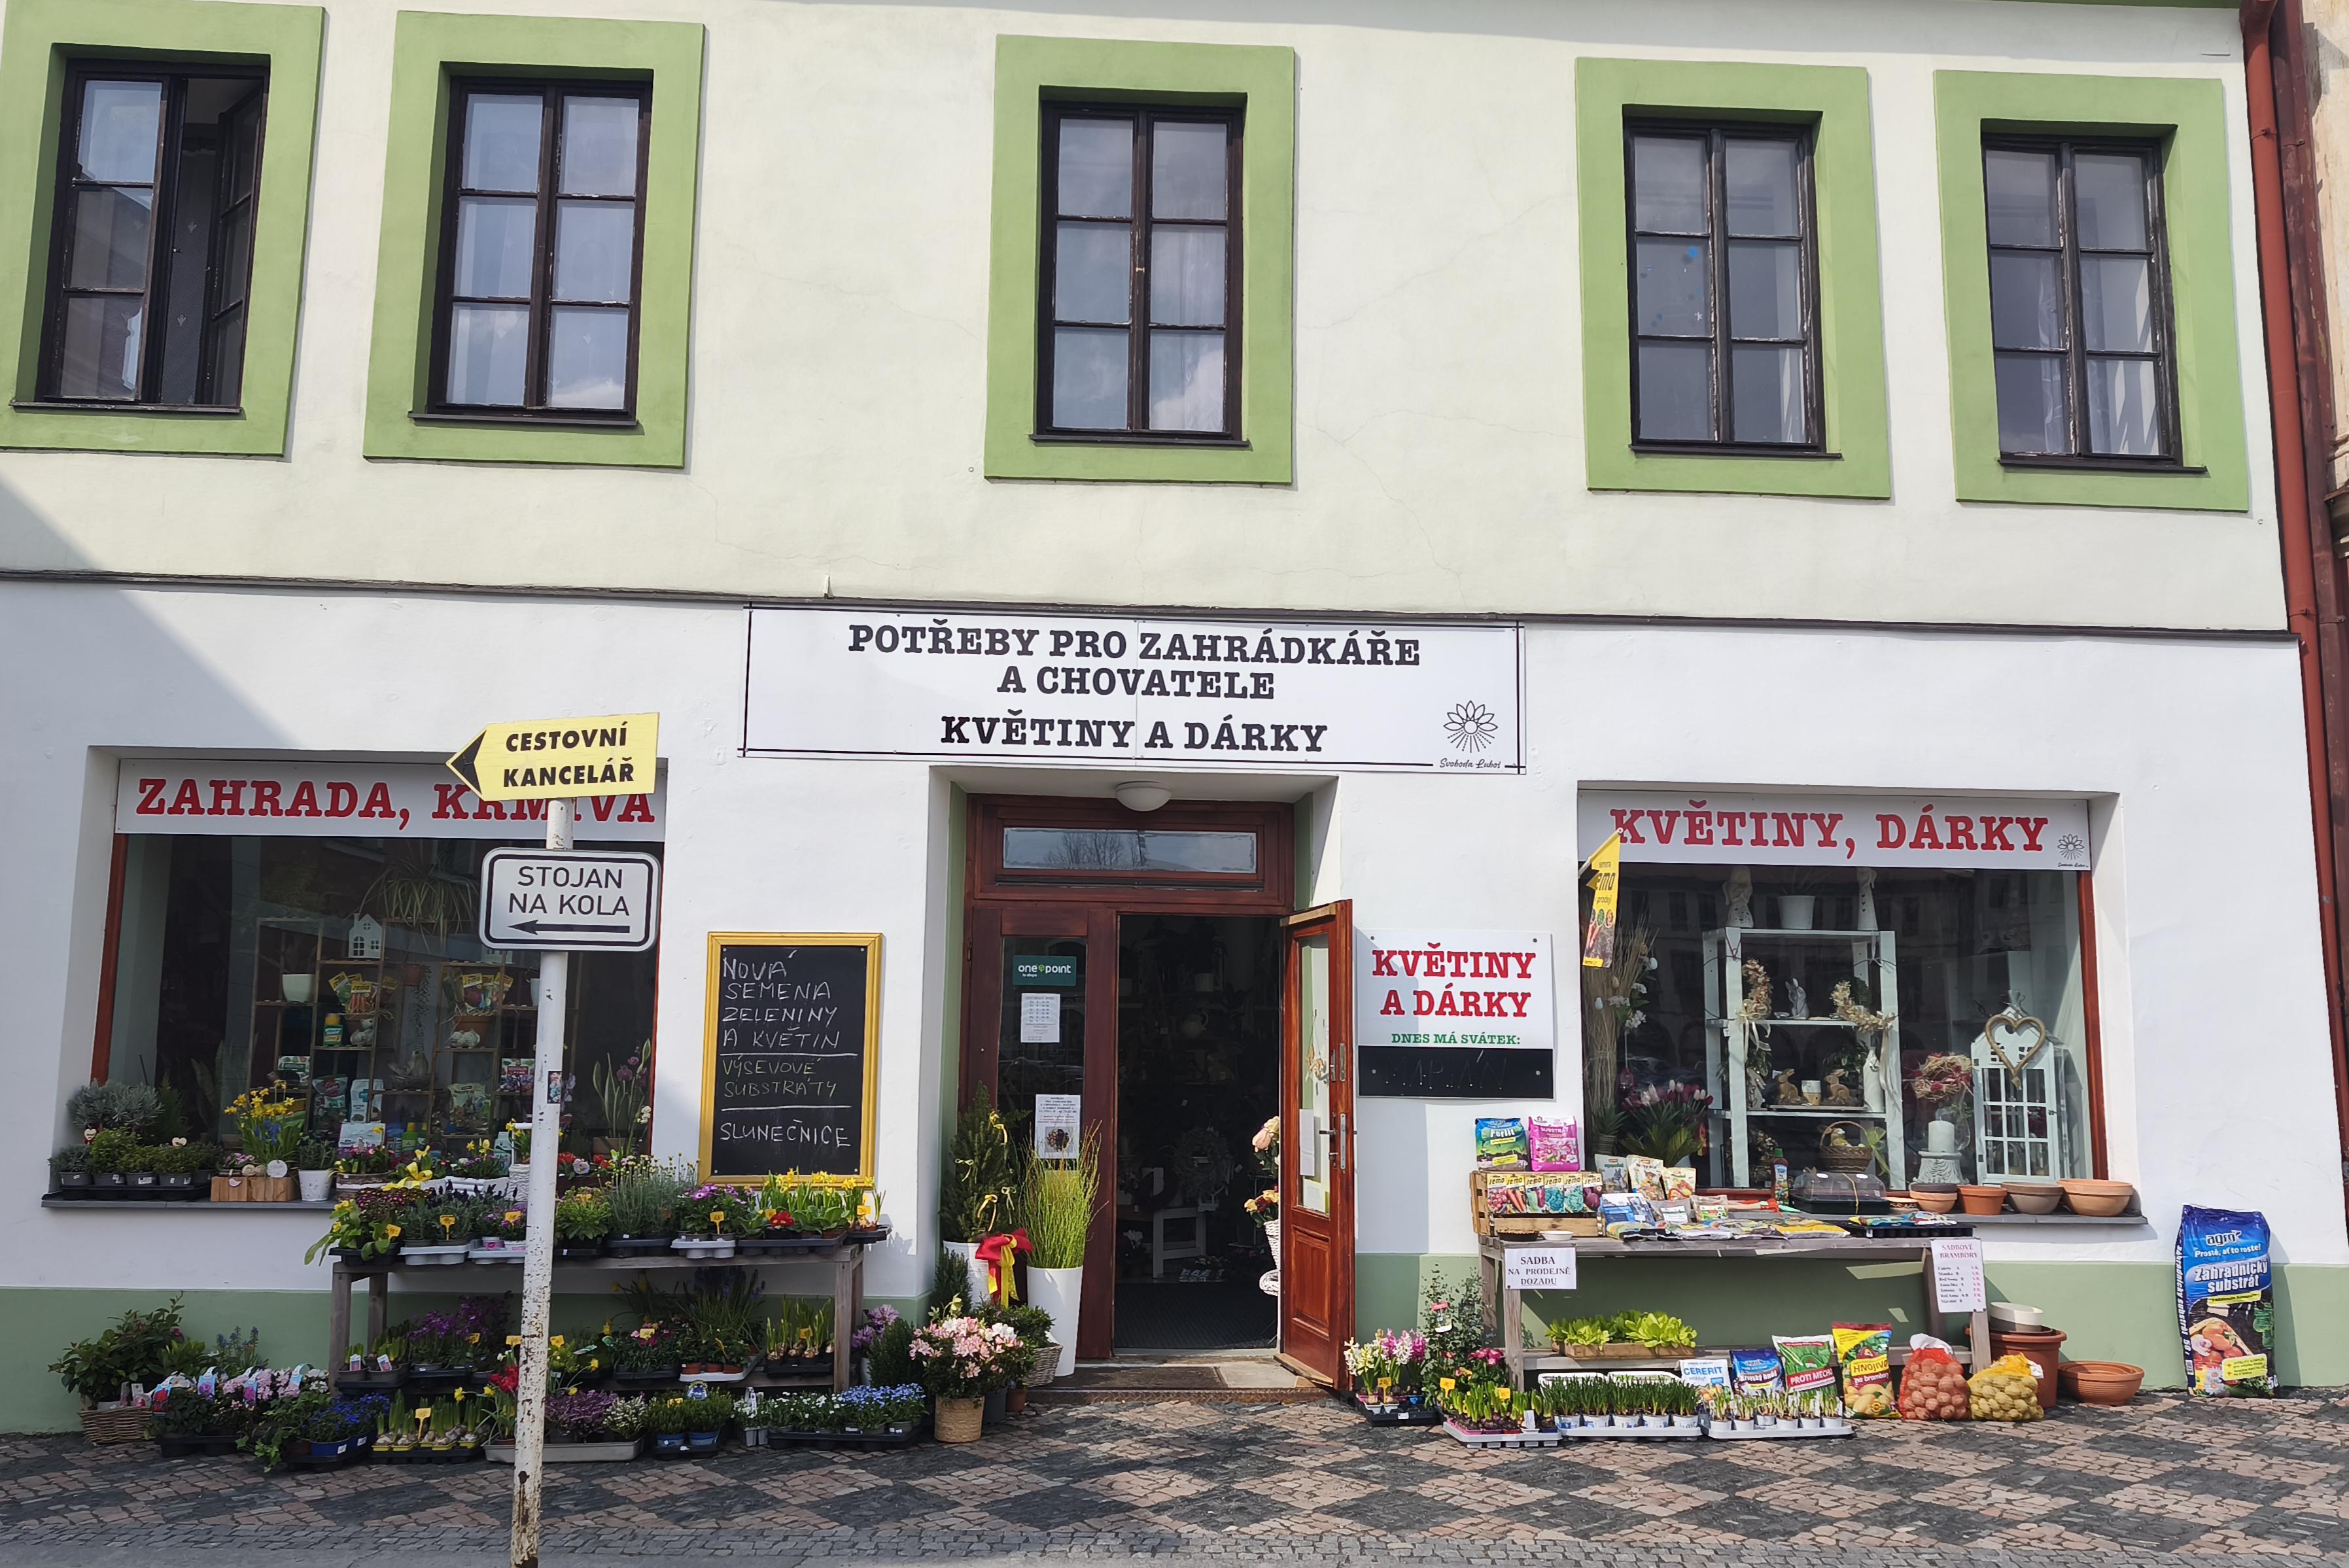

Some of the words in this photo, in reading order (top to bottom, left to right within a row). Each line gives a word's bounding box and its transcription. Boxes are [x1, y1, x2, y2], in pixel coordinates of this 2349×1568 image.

[848, 618, 1039, 655] POTŘEBY
[1049, 629, 1126, 658] PRO
[1138, 627, 1420, 666] ZAHRÁDKÁŘE
[997, 665, 1027, 693] A
[1037, 666, 1274, 699] CHOVATELE
[506, 721, 628, 752] CESTOVNÍ
[941, 708, 1135, 748] KVĚTINY
[1145, 721, 1174, 749] A
[1184, 714, 1327, 752] DÁRKY
[503, 757, 635, 788] KANCELÁŘ
[1440, 758, 1473, 768] Svoboda
[136, 778, 410, 831] ZAHRADA,
[432, 784, 655, 822] KRVA
[1609, 799, 1855, 860] KVĚTINY,
[1876, 804, 2049, 852] DÁRKY
[517, 865, 623, 889] STOJAN
[1595, 873, 1616, 890] emo
[508, 893, 548, 914] NA
[559, 894, 630, 916] KOLA
[723, 949, 797, 981] NOVÁ
[1045, 964, 1071, 974] point
[1372, 942, 1536, 979] KVĚTINY
[724, 981, 831, 1000] SEMENA
[1380, 989, 1405, 1015] A
[1413, 983, 1531, 1017] DÁRKY
[722, 1006, 837, 1028] ZELENINY
[723, 1028, 738, 1047] A
[752, 1026, 840, 1049] KVĚTIN
[1391, 1034, 1430, 1044] DNES
[1433, 1032, 1457, 1044] MÁ
[1461, 1032, 1521, 1045] SVÁTEK:
[722, 1054, 822, 1077] VÝSEVOVÉ
[724, 1078, 837, 1097] SUBSTRÁTY
[720, 1119, 851, 1147] SLUNEČNICE
[1491, 1129, 1515, 1138] Perlit
[2207, 1232, 2235, 1245] agro
[1520, 1256, 1555, 1264] SADBA
[1526, 1266, 1570, 1275] PRODEJNĚ
[2195, 1260, 2269, 1281] Zahradnický
[2207, 1274, 2260, 1294] substrát
[1683, 1367, 1722, 1376] CERERIT
[1853, 1360, 1888, 1373] HNOJIVO
[1790, 1374, 1812, 1385] PROTI
